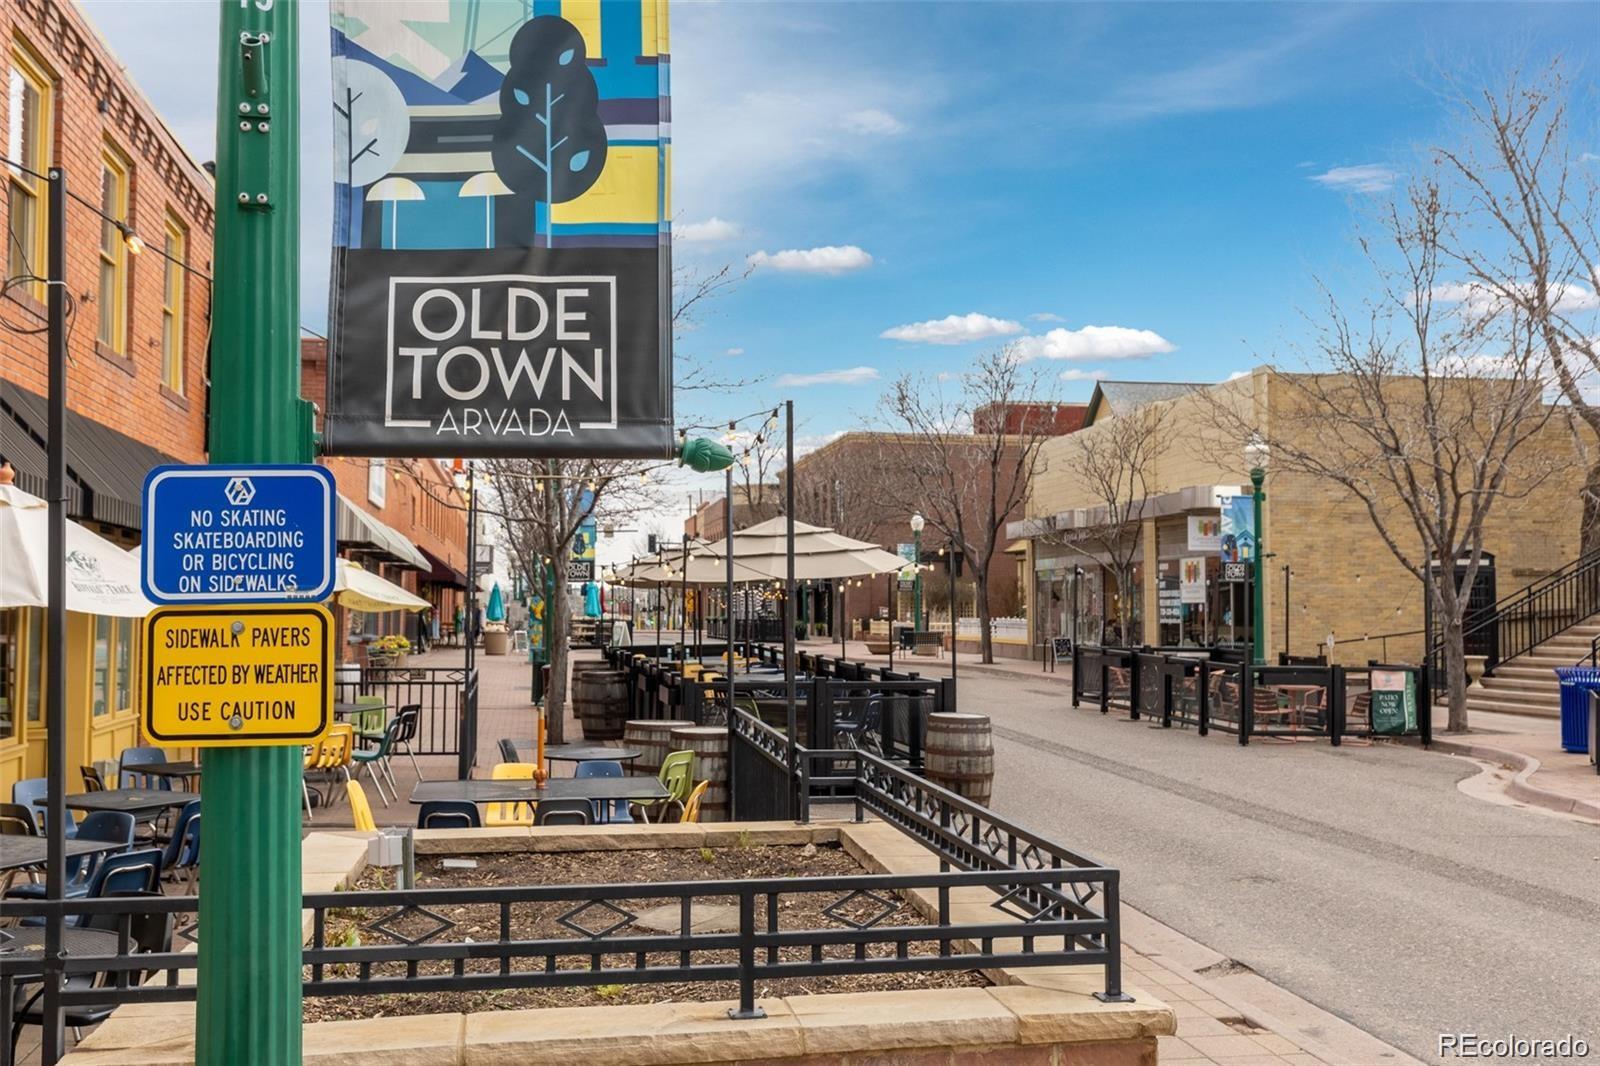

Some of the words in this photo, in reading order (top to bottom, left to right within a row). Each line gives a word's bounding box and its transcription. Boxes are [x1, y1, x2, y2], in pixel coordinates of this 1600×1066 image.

[412, 287, 590, 341] OLDE
[398, 346, 603, 401] TOWN
[436, 408, 574, 437] ARVADA
[191, 510, 213, 527] NO
[220, 509, 286, 527] SKATING
[173, 531, 304, 550] SKATEBOARDING
[182, 554, 204, 571] OR
[212, 553, 294, 571] BICYCLING
[179, 575, 200, 593] ON
[209, 574, 297, 592] SIDEWALKS
[165, 628, 240, 648] SIDEWALK
[252, 627, 310, 647] PAVERS
[157, 665, 227, 686] AFFECTED
[232, 665, 250, 684] BY
[254, 664, 318, 684] WEATHER
[178, 702, 211, 721] USE
[220, 701, 295, 720] CAUTION
